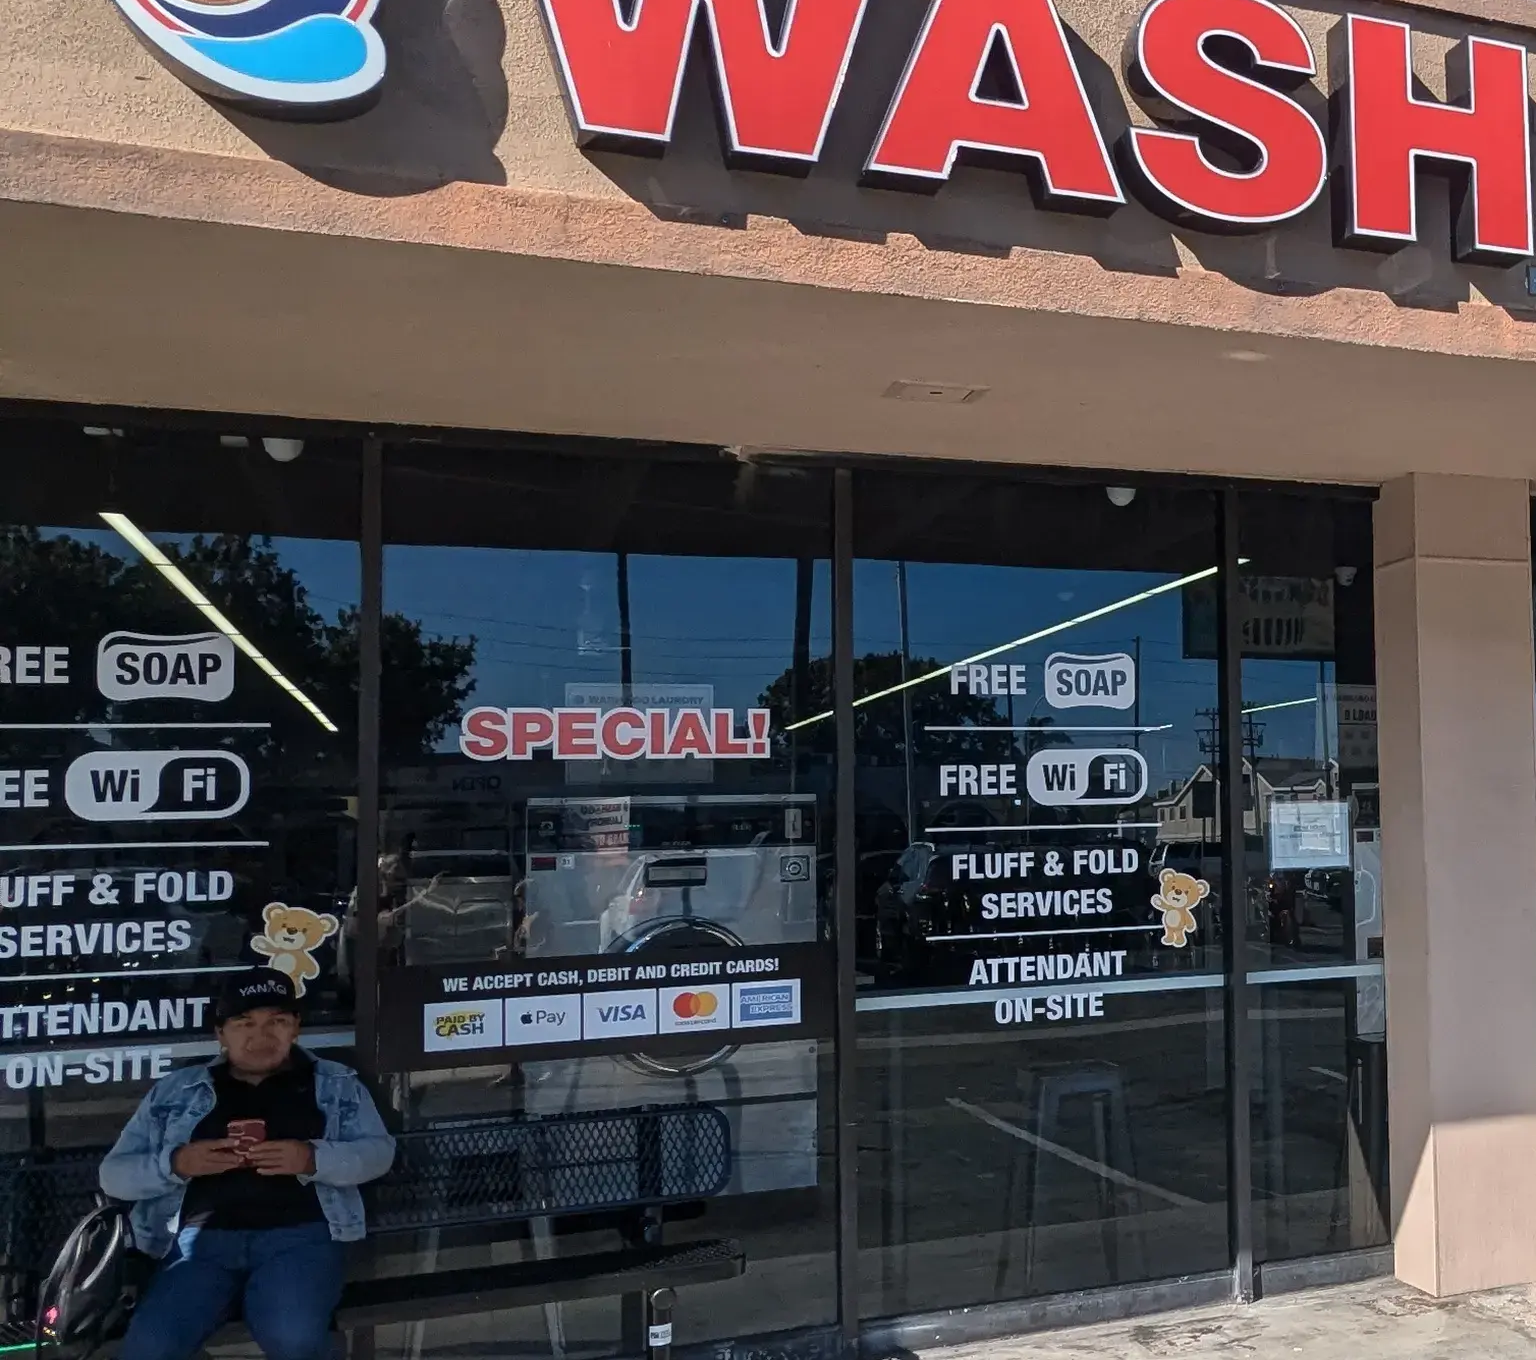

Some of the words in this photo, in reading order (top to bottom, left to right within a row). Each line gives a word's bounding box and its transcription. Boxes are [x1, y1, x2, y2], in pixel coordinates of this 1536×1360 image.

[115, 652, 222, 685] SOAP
[951, 664, 1027, 695] FREE
[1056, 669, 1127, 696] SOAP
[460, 706, 770, 761] SPECIAL!
[940, 764, 1017, 796] FREE
[952, 851, 1035, 880] FLUFF
[1043, 850, 1064, 877] &
[1073, 848, 1139, 875] FOLD
[88, 873, 119, 905] &
[134, 870, 234, 904] FOLD
[981, 888, 1113, 920] SERVICES
[443, 977, 468, 993] WE
[473, 973, 532, 990] ACCEPT
[538, 970, 584, 988] CASH,
[587, 967, 631, 983] DEBIT
[635, 965, 666, 980] AND
[671, 961, 723, 977] CREDIT
[726, 958, 780, 974] CARDS!
[969, 950, 1127, 985] ATTENDANT
[0, 997, 210, 1039] TTENDANT
[436, 1015, 465, 1025] PAID
[469, 1012, 485, 1022] BY
[535, 1009, 566, 1027] Pay
[600, 1004, 646, 1023] VISA
[995, 992, 1104, 1025] ON-SITE
[435, 1022, 485, 1038] CASH
[6, 1047, 173, 1089] ON-SITE
